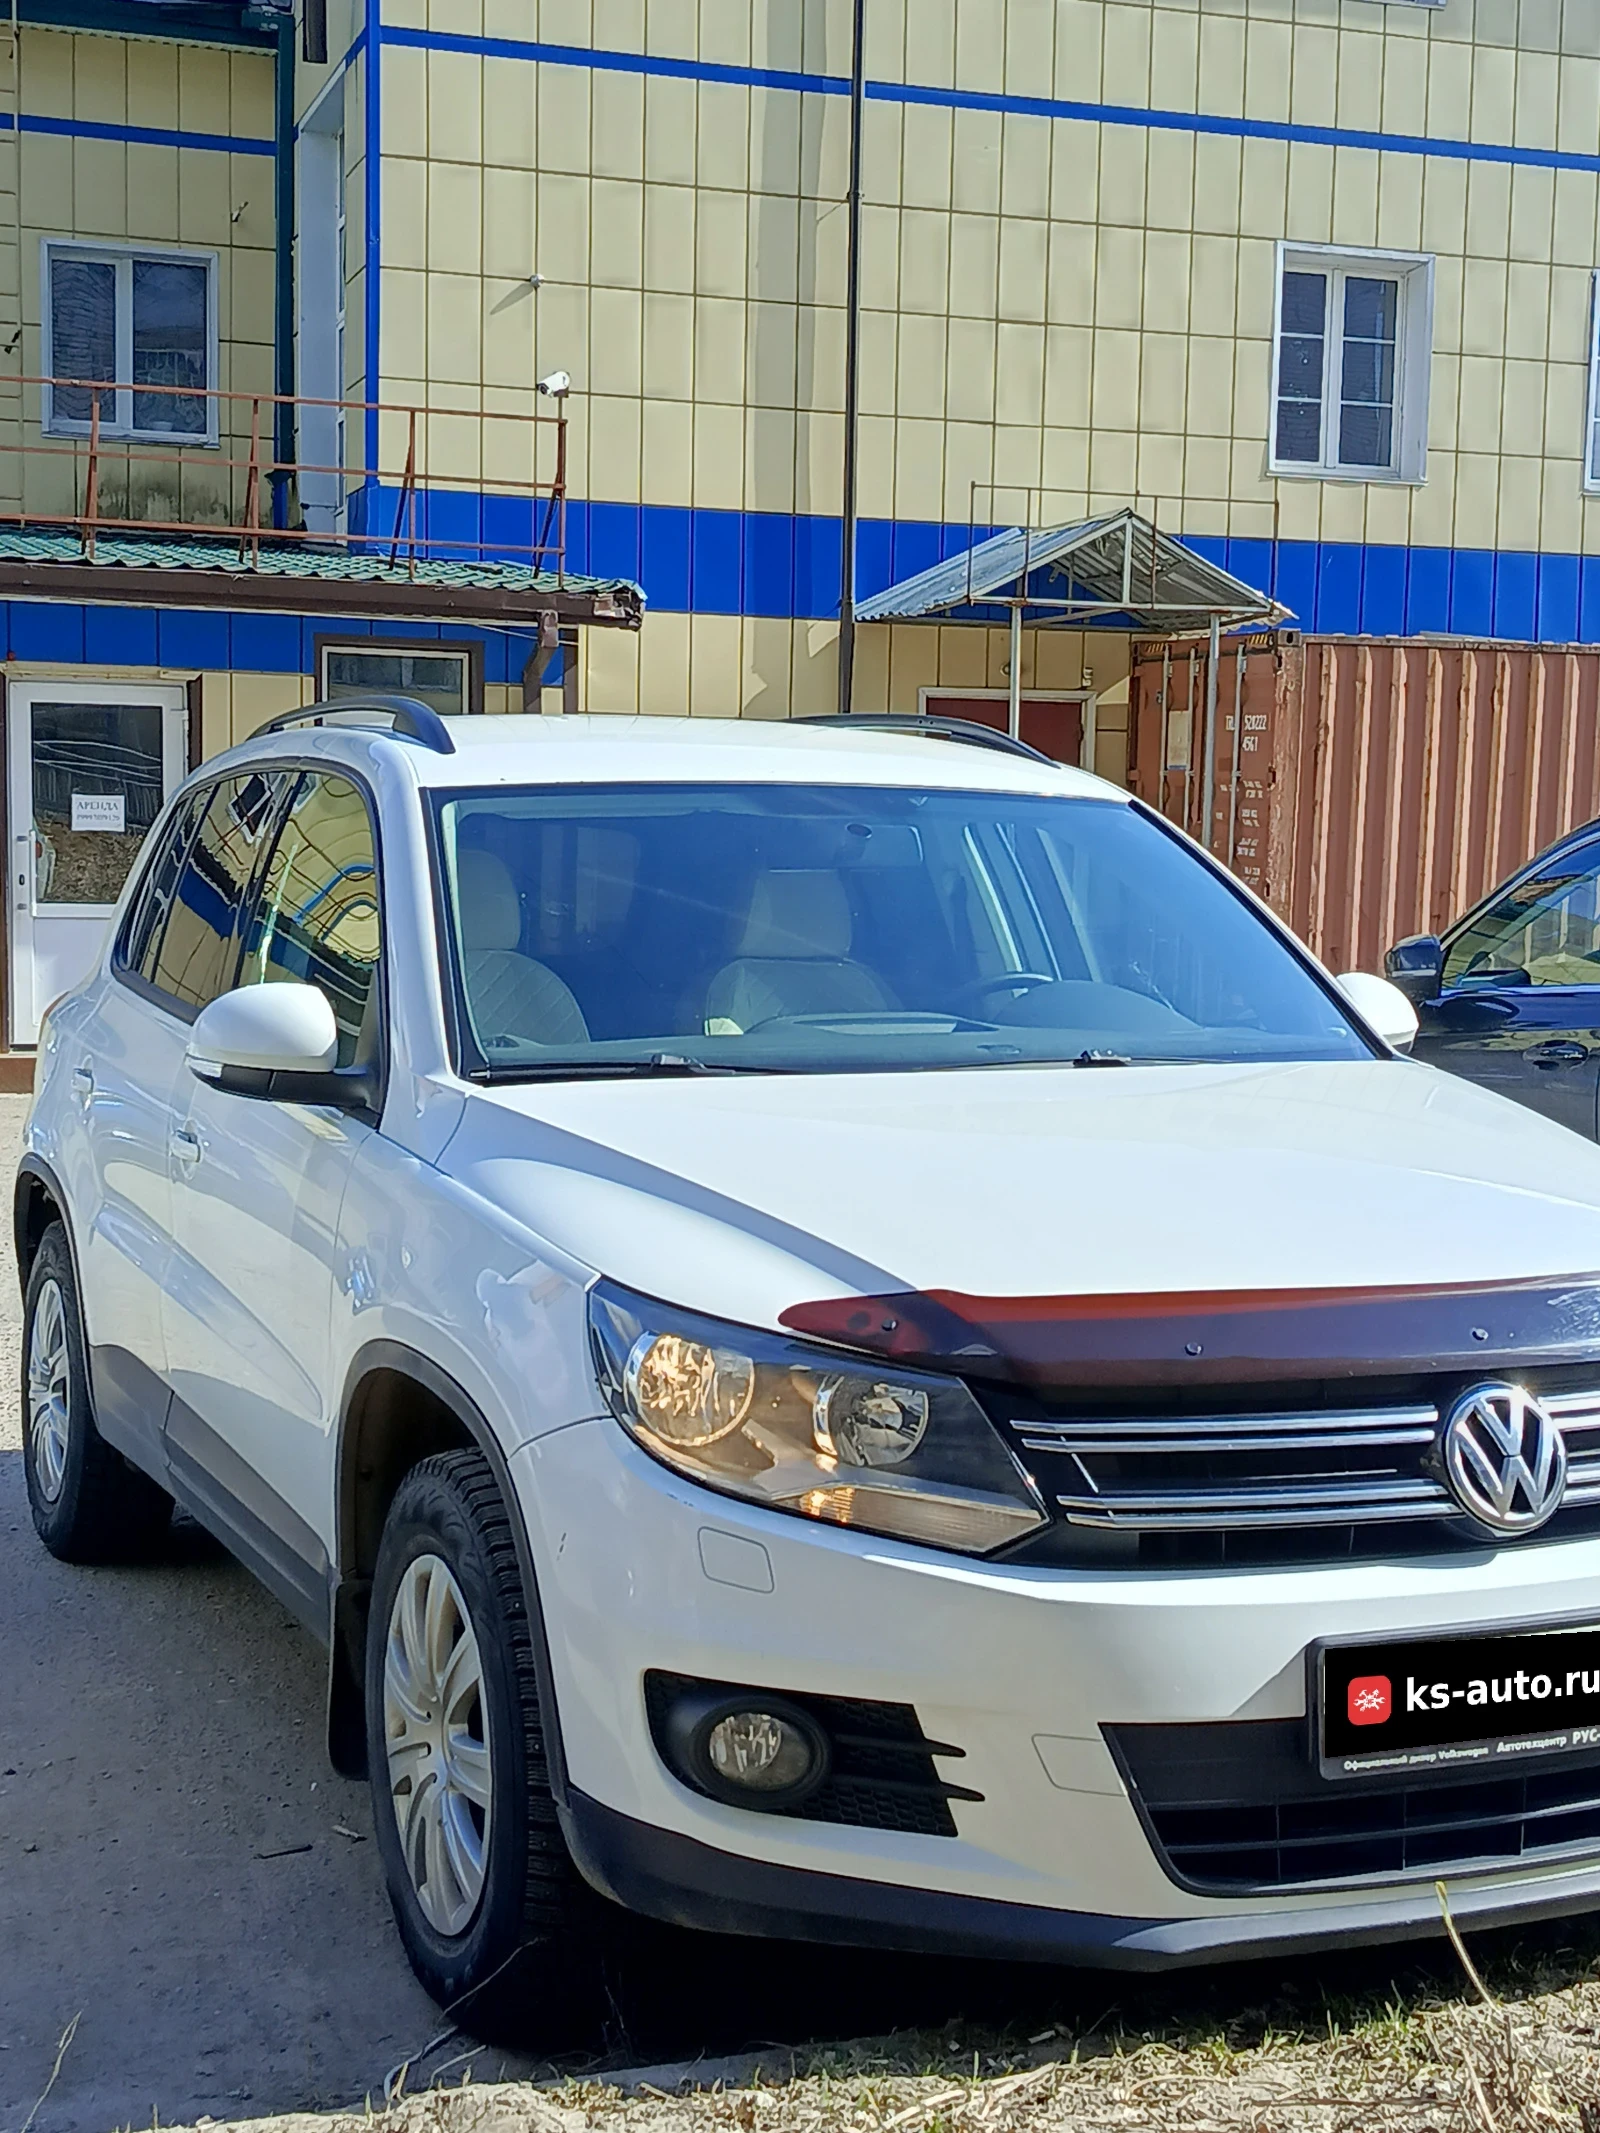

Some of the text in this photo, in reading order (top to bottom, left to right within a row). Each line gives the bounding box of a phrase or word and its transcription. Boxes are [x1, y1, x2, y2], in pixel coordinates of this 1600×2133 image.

[77, 801, 118, 811] АРЕНДА
[1343, 1754, 1408, 1771] Официальный
[1438, 1747, 1489, 1760] Volkswagen
[1496, 1736, 1567, 1753] Автотехцентр
